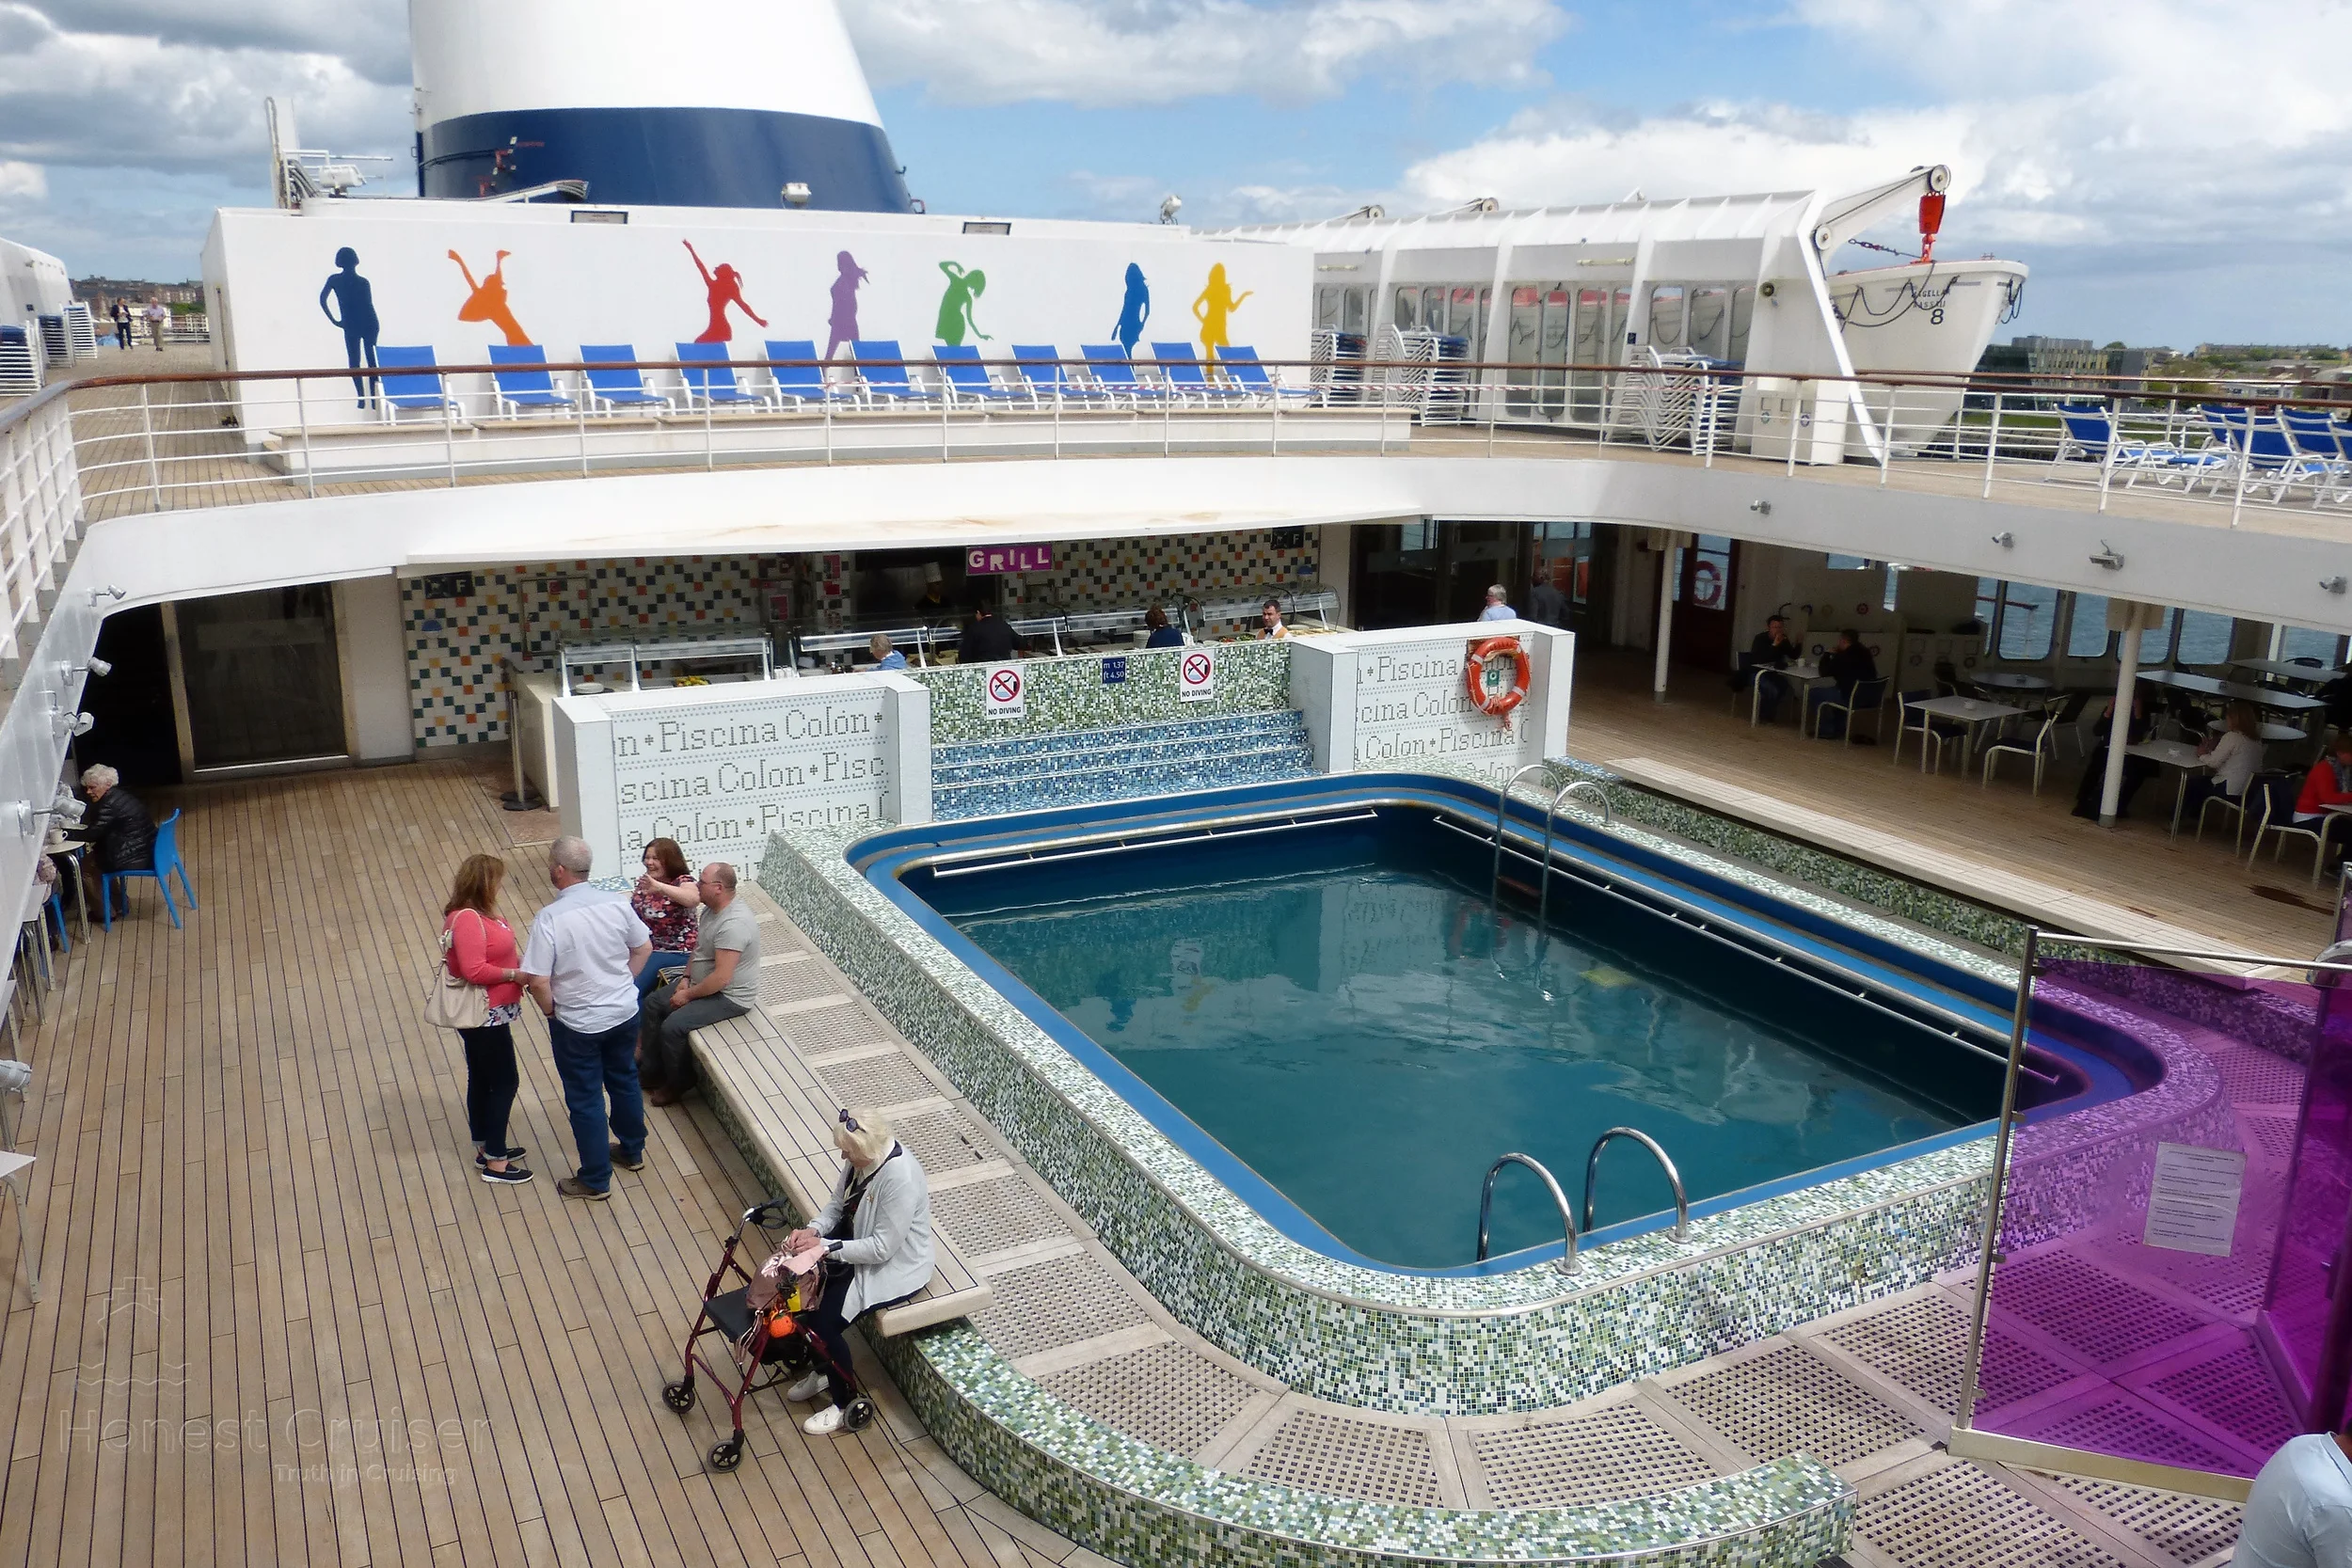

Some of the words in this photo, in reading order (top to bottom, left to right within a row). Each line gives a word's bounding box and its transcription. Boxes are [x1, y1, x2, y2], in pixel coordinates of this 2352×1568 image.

[1931, 309, 1945, 325] 8
[968, 547, 1050, 571] GRILL
[1103, 671, 1109, 680] ft
[1110, 671, 1125, 679] 4.50
[1376, 655, 1458, 682] Piscina
[1191, 689, 1212, 697] DIVING
[998, 706, 1022, 715] DIVING
[1356, 698, 1409, 723] cina
[659, 719, 779, 753] Piscina
[1438, 727, 1516, 753] Piscina
[620, 771, 712, 805] scina
[822, 752, 889, 783] Pisc
